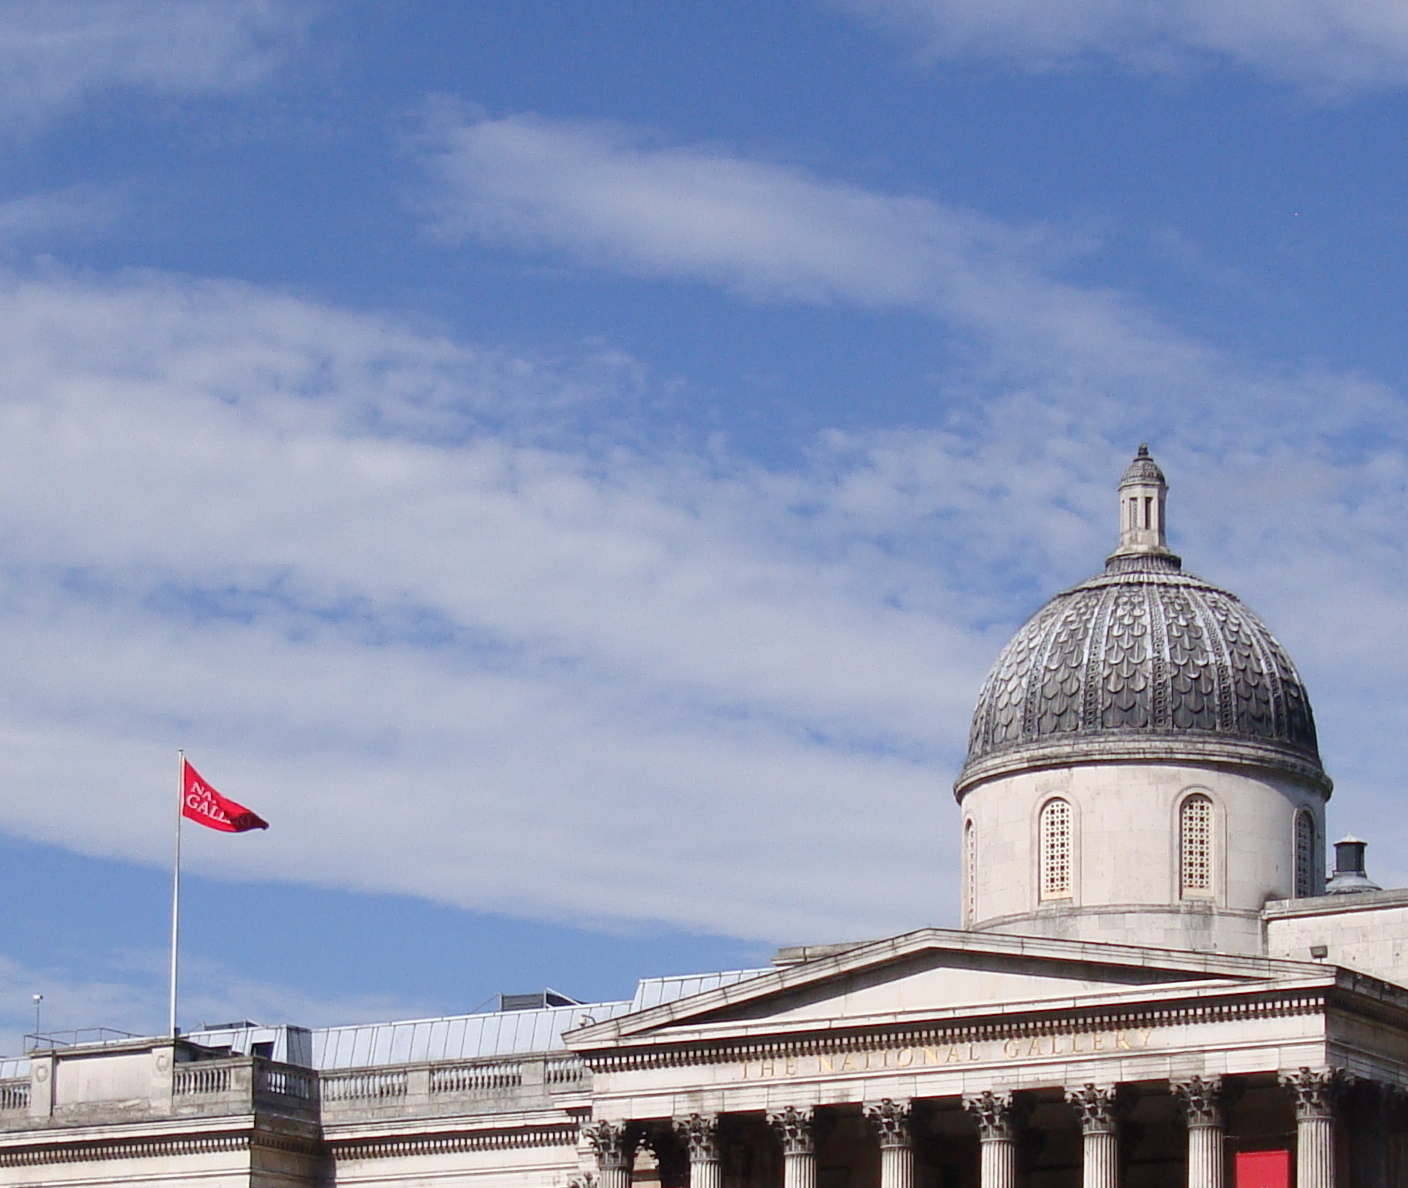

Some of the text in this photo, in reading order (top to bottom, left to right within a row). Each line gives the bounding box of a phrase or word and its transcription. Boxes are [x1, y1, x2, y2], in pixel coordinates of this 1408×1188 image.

[740, 1028, 1154, 1080] THE NATIONAL GALLERY
